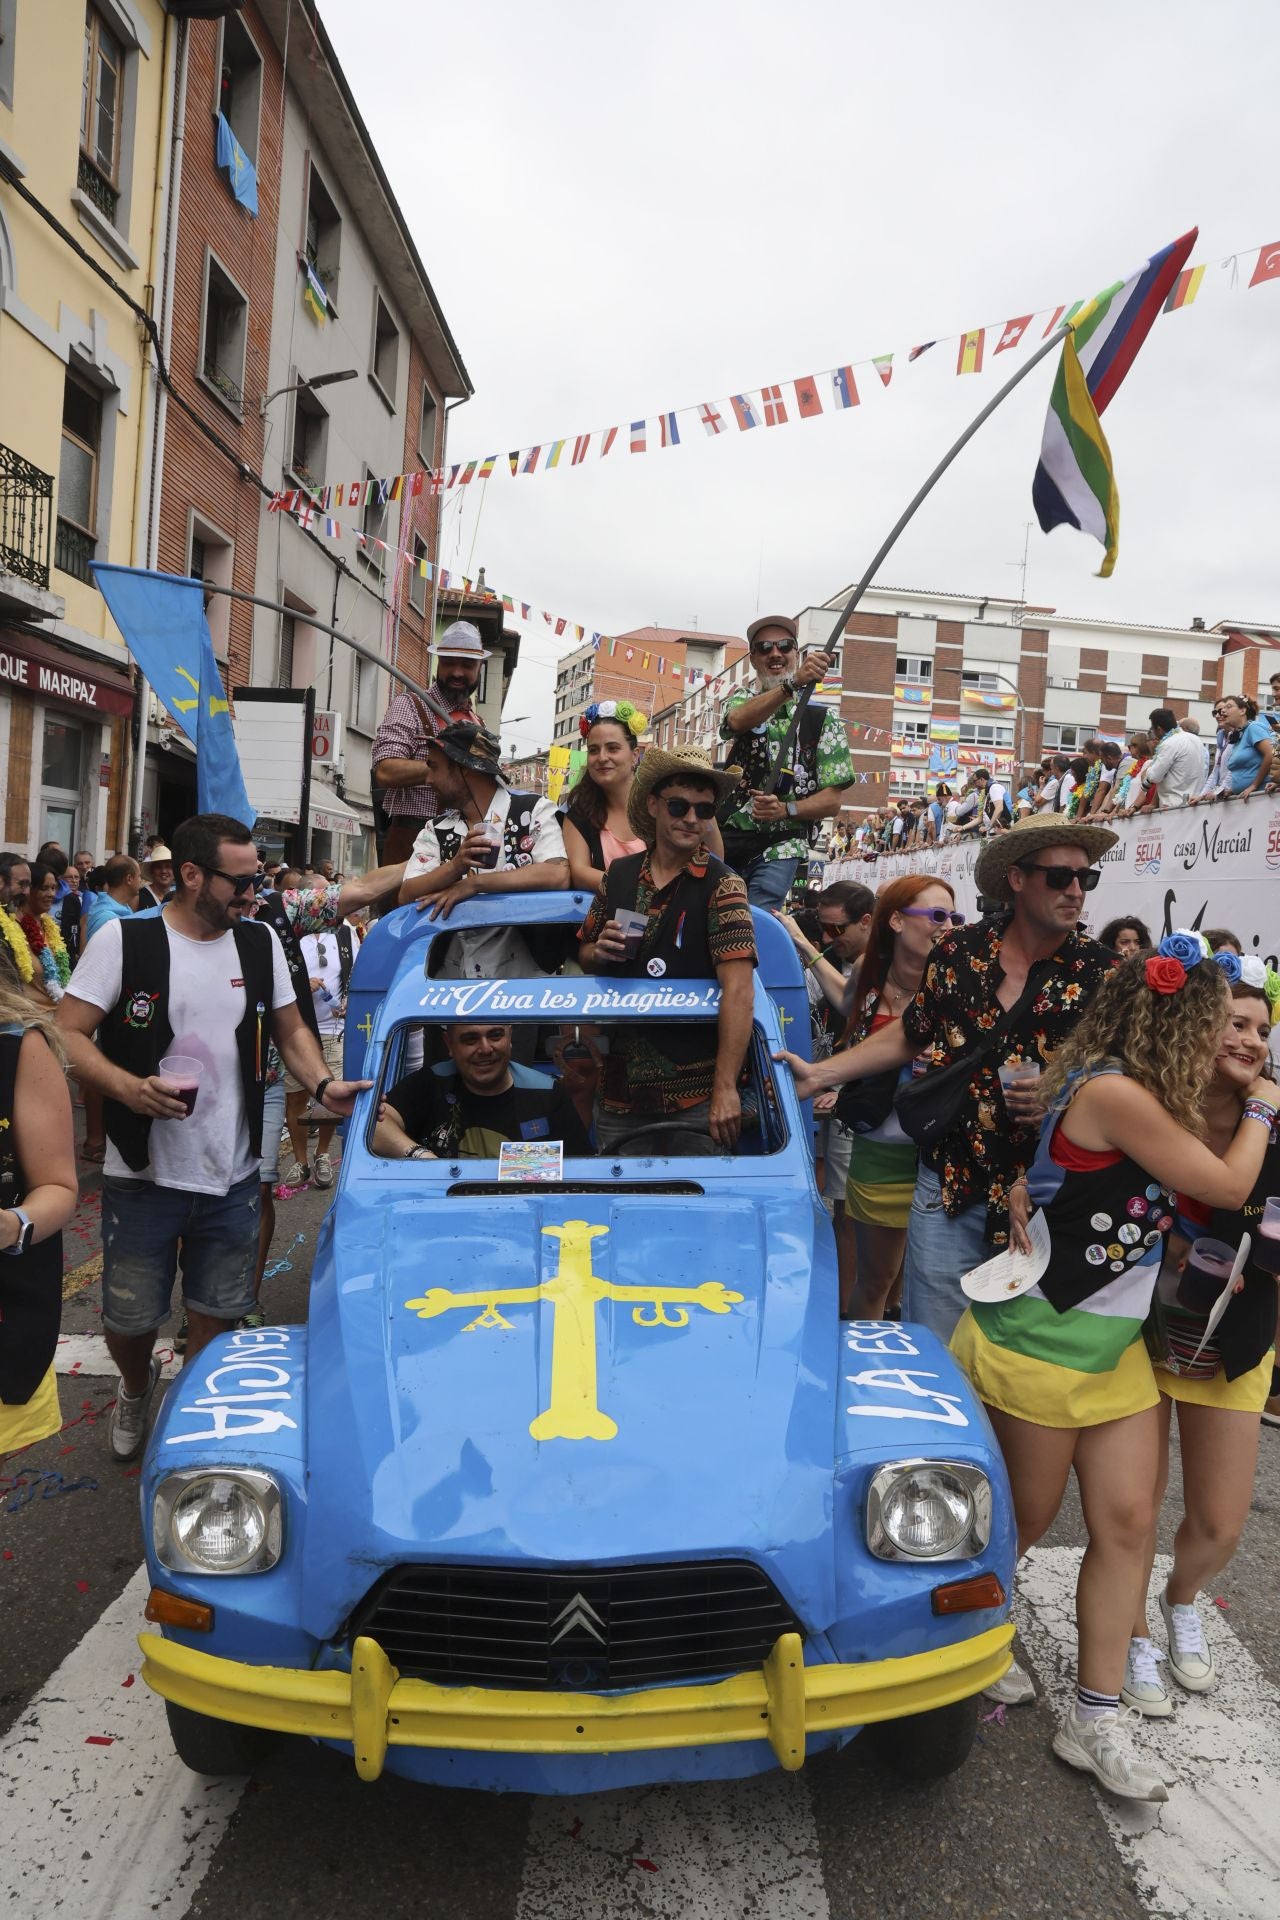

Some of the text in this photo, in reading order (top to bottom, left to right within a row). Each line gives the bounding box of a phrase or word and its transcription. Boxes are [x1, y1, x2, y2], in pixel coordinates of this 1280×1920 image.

[0, 653, 97, 705] QUE MARIPAZ
[1136, 842, 1162, 862] SELLA
[1173, 819, 1252, 870] casa Marcial
[539, 989, 578, 1010] les
[845, 1368, 969, 1427] LA
